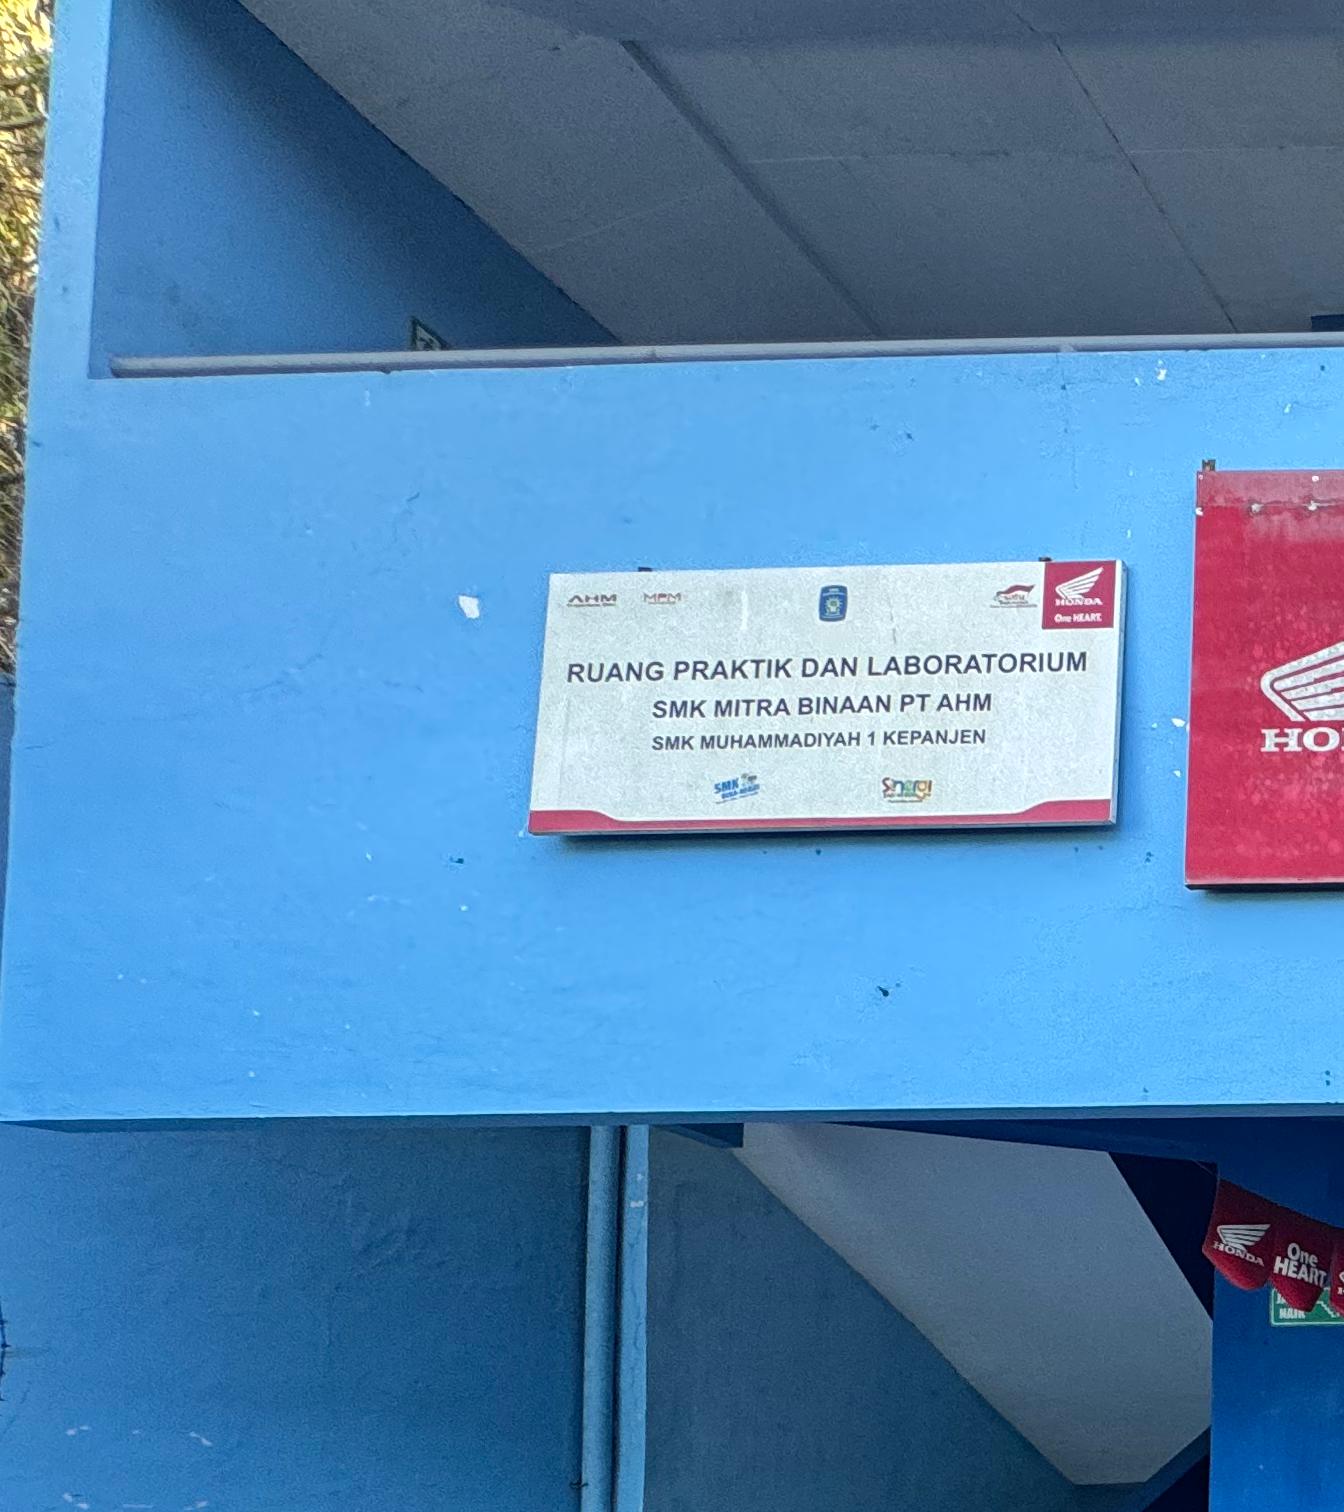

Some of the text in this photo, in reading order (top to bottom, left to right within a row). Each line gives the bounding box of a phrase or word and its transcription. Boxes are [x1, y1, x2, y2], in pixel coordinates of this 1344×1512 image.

[567, 652, 1087, 683] RUANG PRAKTIK DAN LABORATORIUM
[652, 693, 992, 719] SMK MITRA BINAAN PT AHM
[652, 729, 986, 750] SMK MUHAMMADIYAH 1 KEPANJEN
[1212, 1240, 1265, 1267] HONDA
[1287, 1243, 1318, 1266] One
